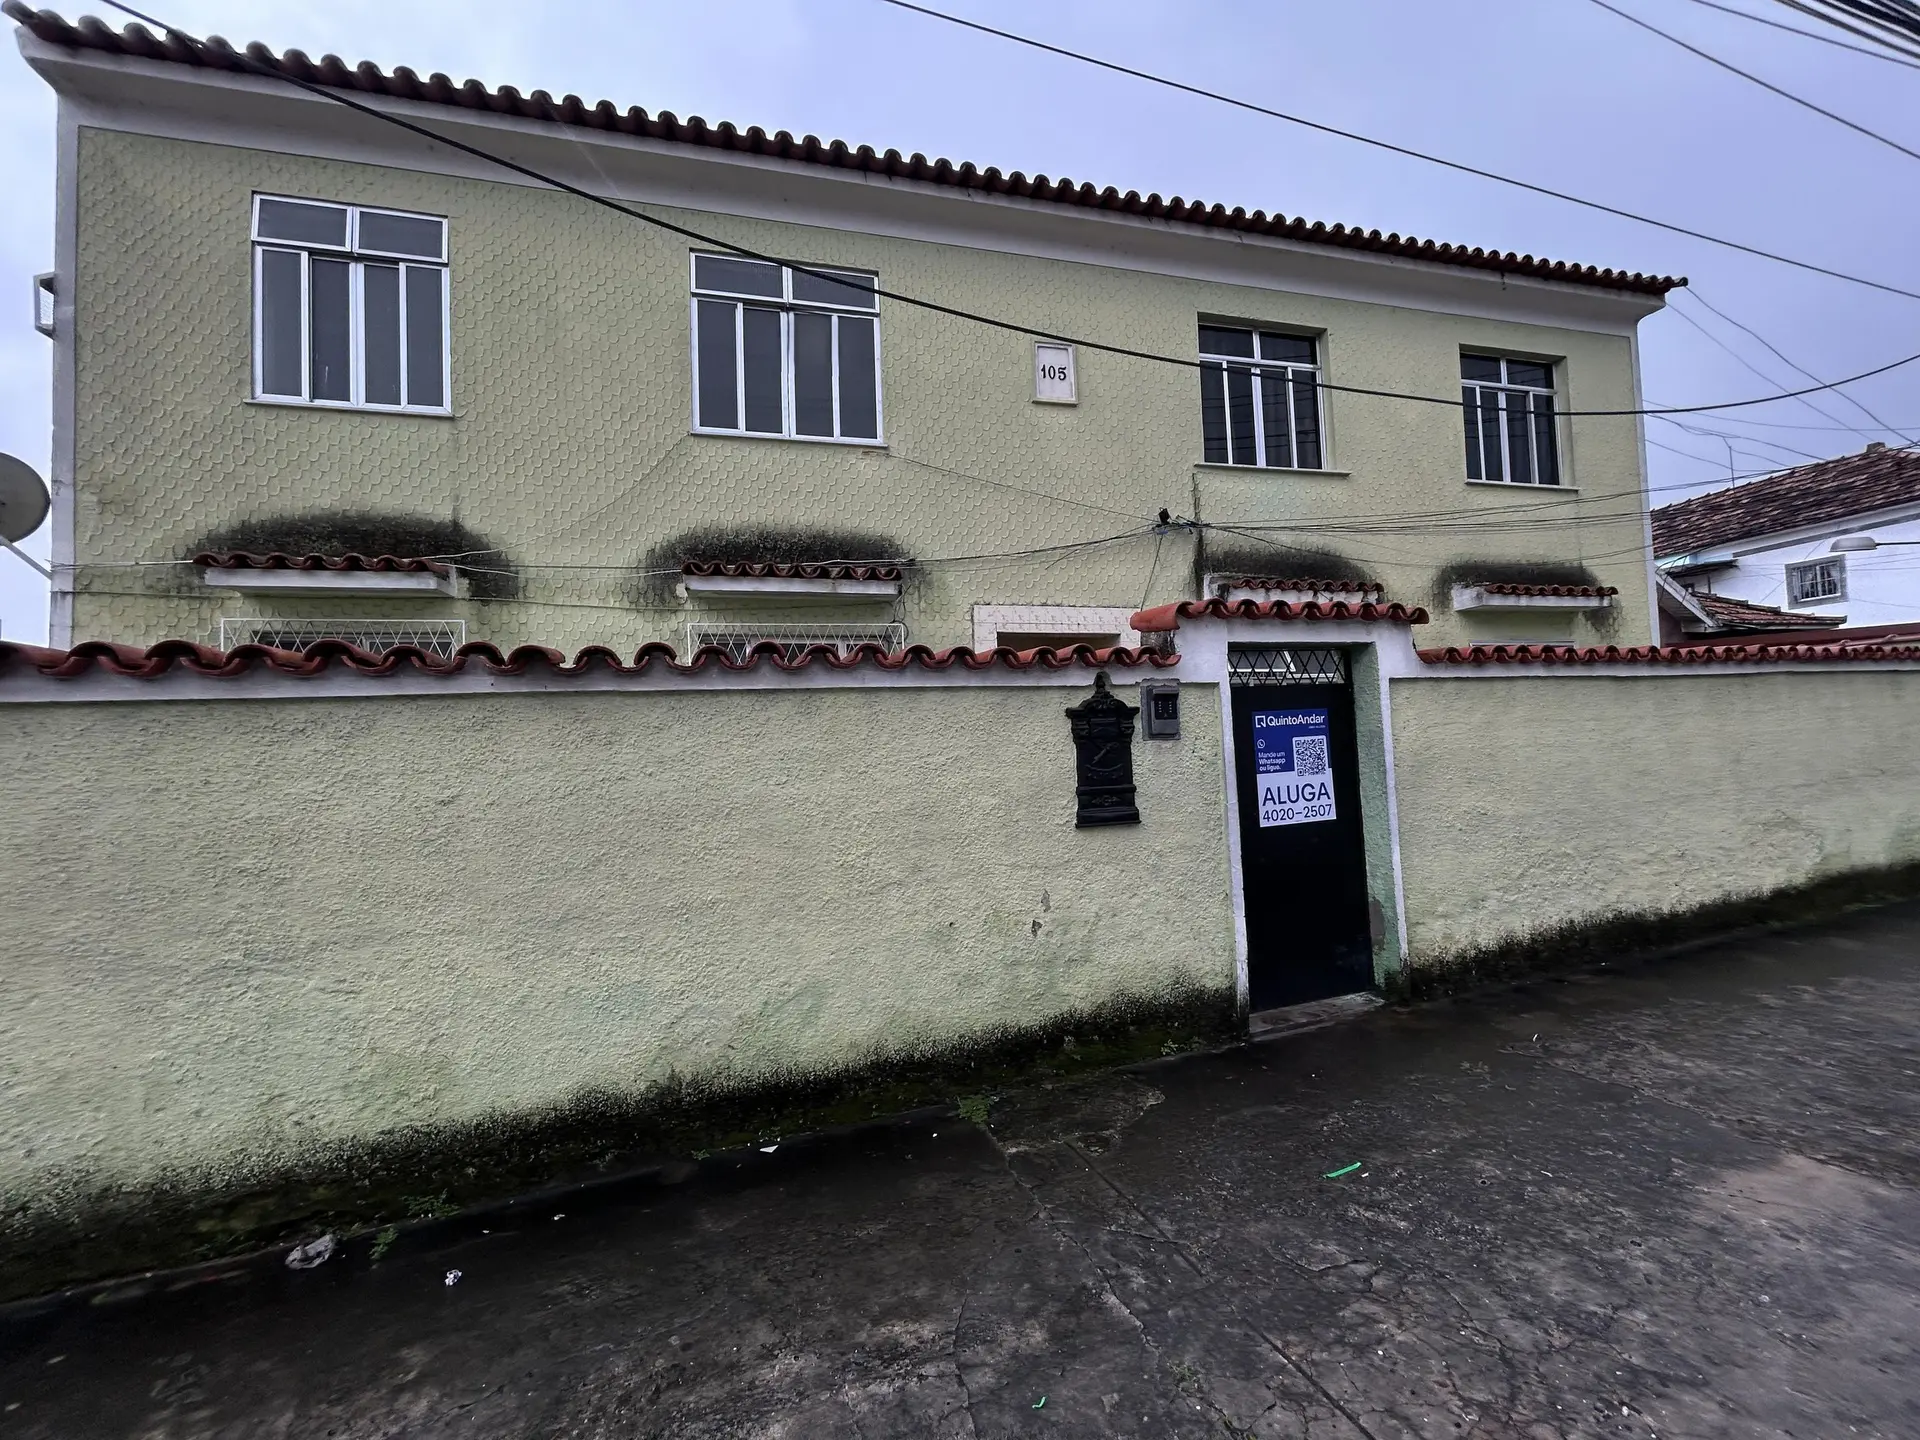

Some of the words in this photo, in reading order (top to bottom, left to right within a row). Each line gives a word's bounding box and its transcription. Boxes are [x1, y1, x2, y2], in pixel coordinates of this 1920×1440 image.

[1041, 364, 1067, 381] 105
[1267, 714, 1325, 726] QuintoAndar
[1262, 782, 1331, 807] ALUGA
[1262, 804, 1332, 822] 4020-2507
